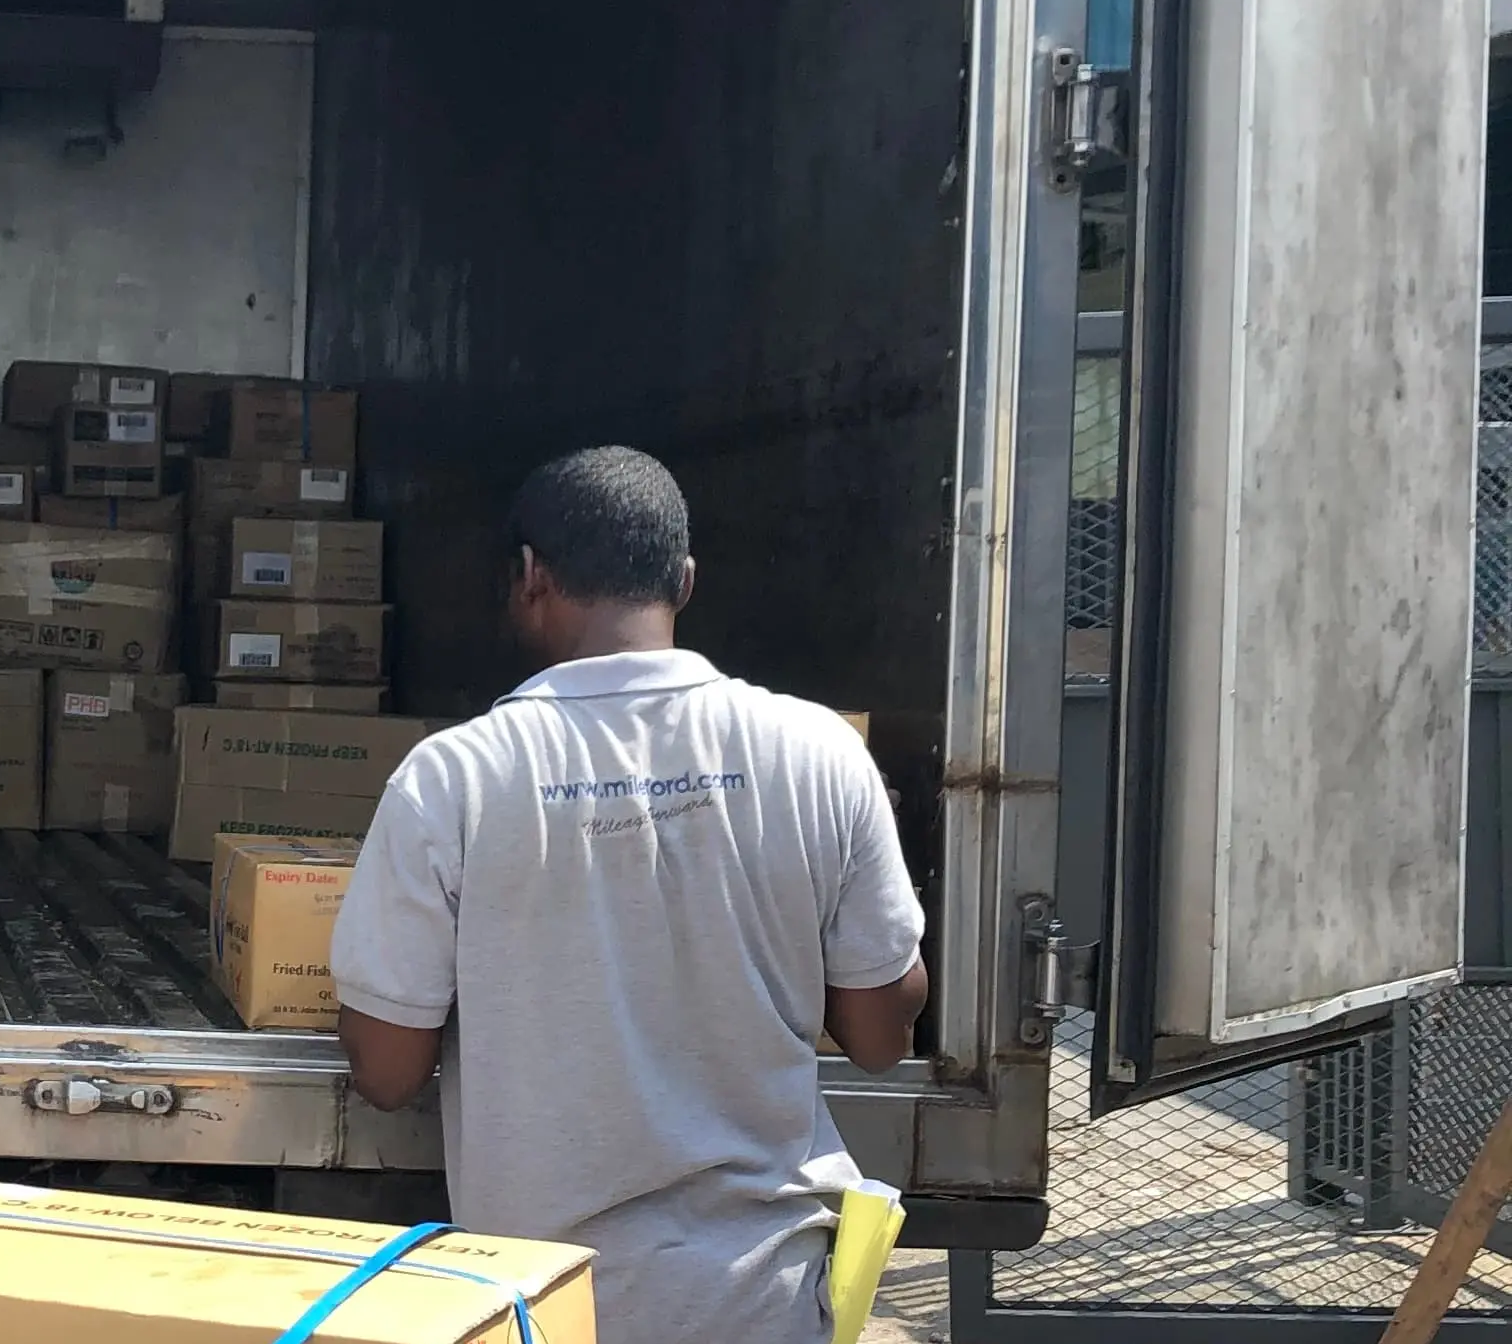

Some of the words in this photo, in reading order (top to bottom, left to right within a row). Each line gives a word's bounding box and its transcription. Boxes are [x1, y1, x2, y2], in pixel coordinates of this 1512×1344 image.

[67, 698, 107, 714] PHB
[273, 740, 329, 759] FROZEN
[332, 745, 368, 761] KEEP
[264, 869, 301, 885] Expiry
[305, 870, 338, 885] Date:
[273, 963, 304, 977] Fried
[307, 964, 331, 978] Fish
[238, 1220, 387, 1244] FROZEN
[418, 1242, 500, 1257] KEE
